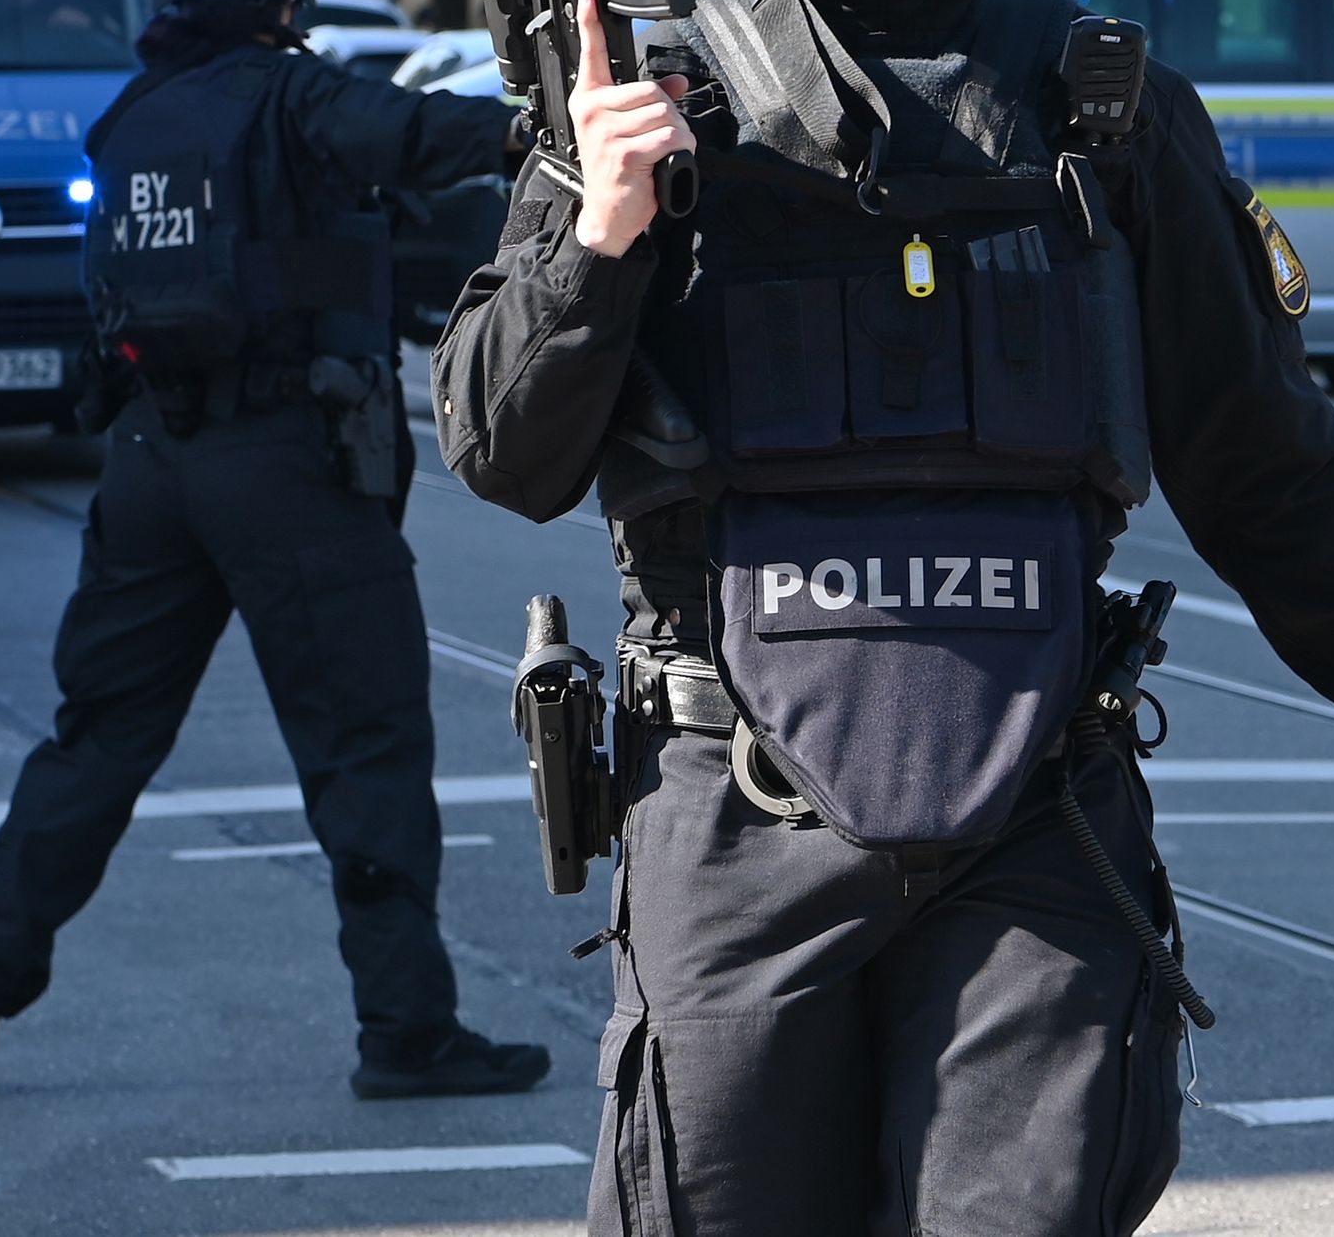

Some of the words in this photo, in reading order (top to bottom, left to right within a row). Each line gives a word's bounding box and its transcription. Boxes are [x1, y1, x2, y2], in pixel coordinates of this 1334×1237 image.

[130, 171, 169, 213] BY
[136, 206, 195, 251] 7221
[763, 557, 1040, 614] POLIZEI
